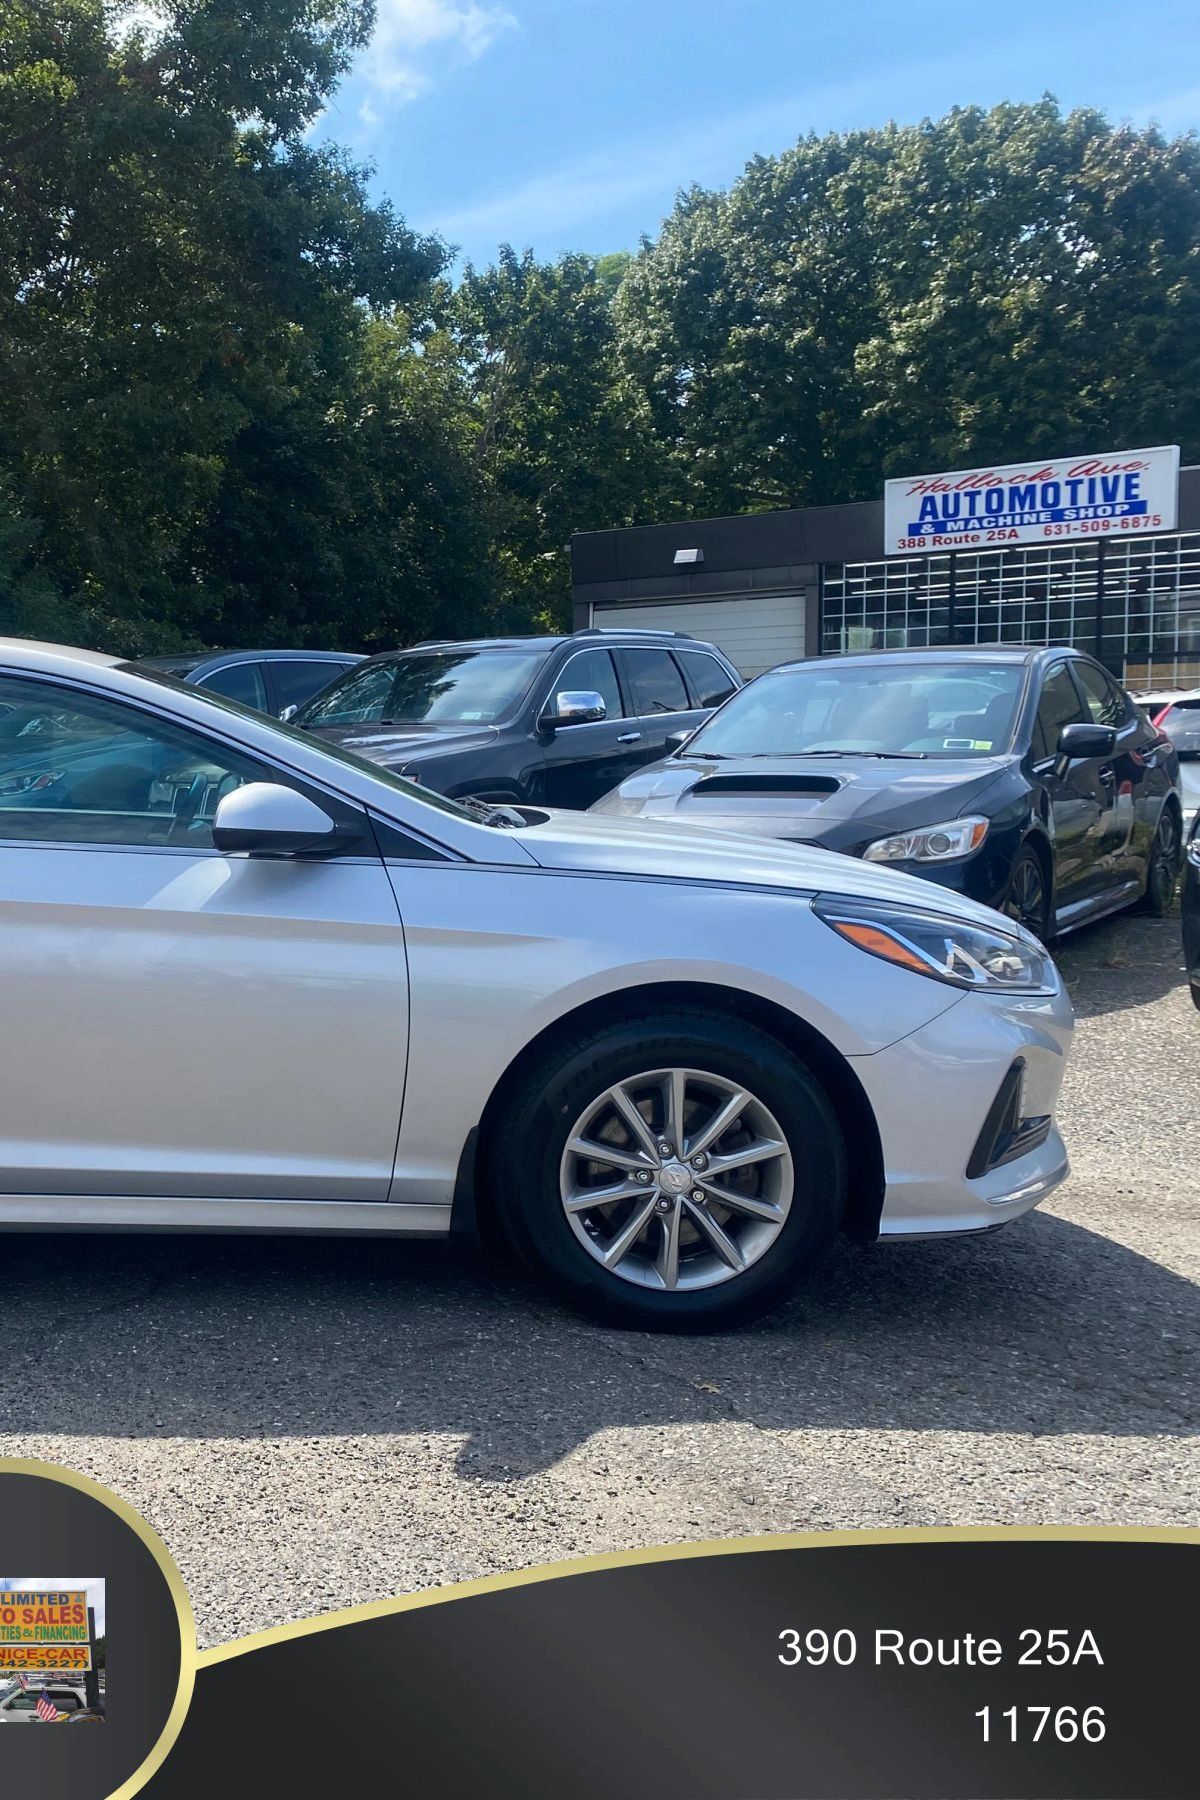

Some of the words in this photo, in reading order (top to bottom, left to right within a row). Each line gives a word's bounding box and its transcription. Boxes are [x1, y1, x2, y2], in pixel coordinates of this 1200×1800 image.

[906, 465, 1061, 497] Hallock
[1068, 459, 1152, 478] Ave.
[918, 472, 1141, 522] AUTOMOTIVE
[897, 536, 927, 550] 388
[932, 532, 981, 546] Route
[986, 527, 1020, 542] 25A
[1043, 513, 1163, 537] 631-509-6875
[920, 522, 936, 535] &
[946, 510, 1052, 532] MACHINE
[1063, 503, 1131, 521] SHOP
